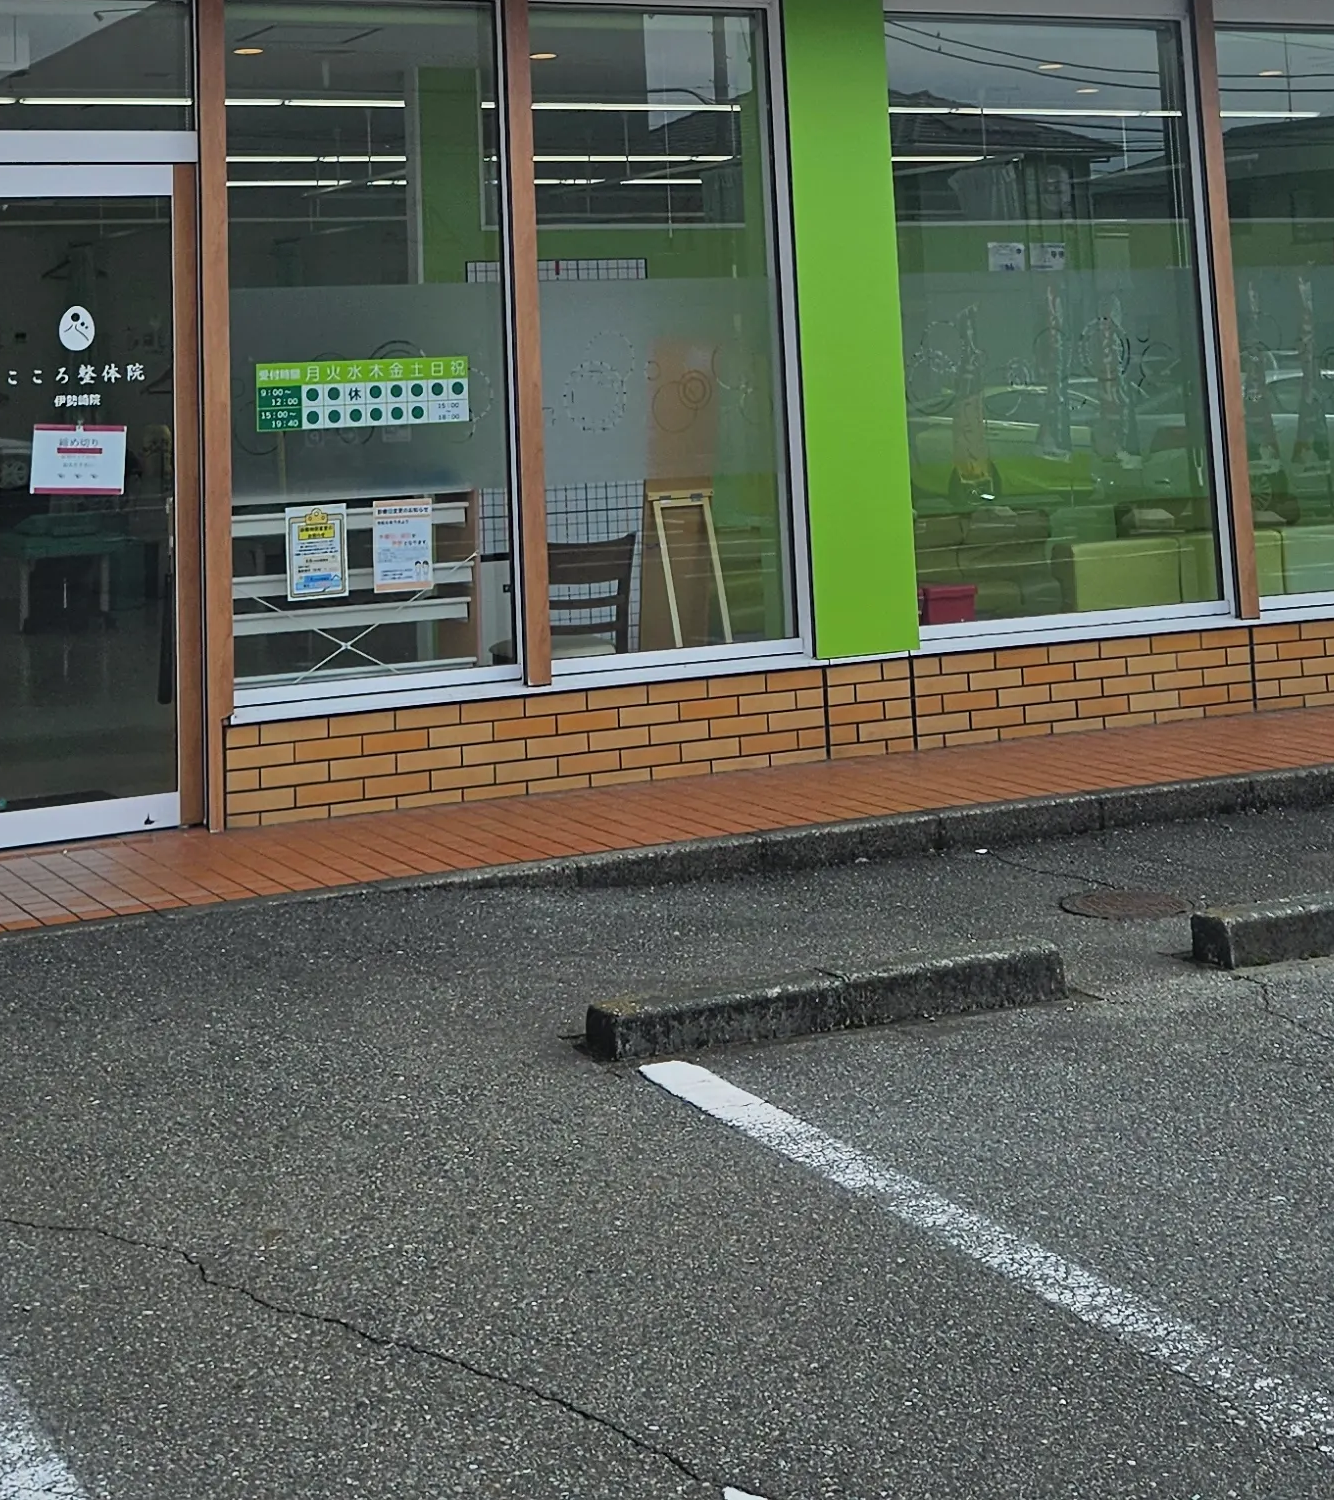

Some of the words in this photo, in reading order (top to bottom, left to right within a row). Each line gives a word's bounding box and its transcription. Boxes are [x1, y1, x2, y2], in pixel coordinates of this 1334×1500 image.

[8, 363, 145, 385] こころ整体院
[306, 366, 320, 381] 月
[326, 366, 341, 380] 火
[347, 365, 362, 379] 水
[369, 363, 384, 378] 木
[389, 362, 403, 377] 金
[410, 362, 424, 377] 土
[432, 361, 443, 375] 日
[451, 360, 465, 375] 祝
[271, 398, 298, 406] 12:00
[348, 387, 362, 401] 休
